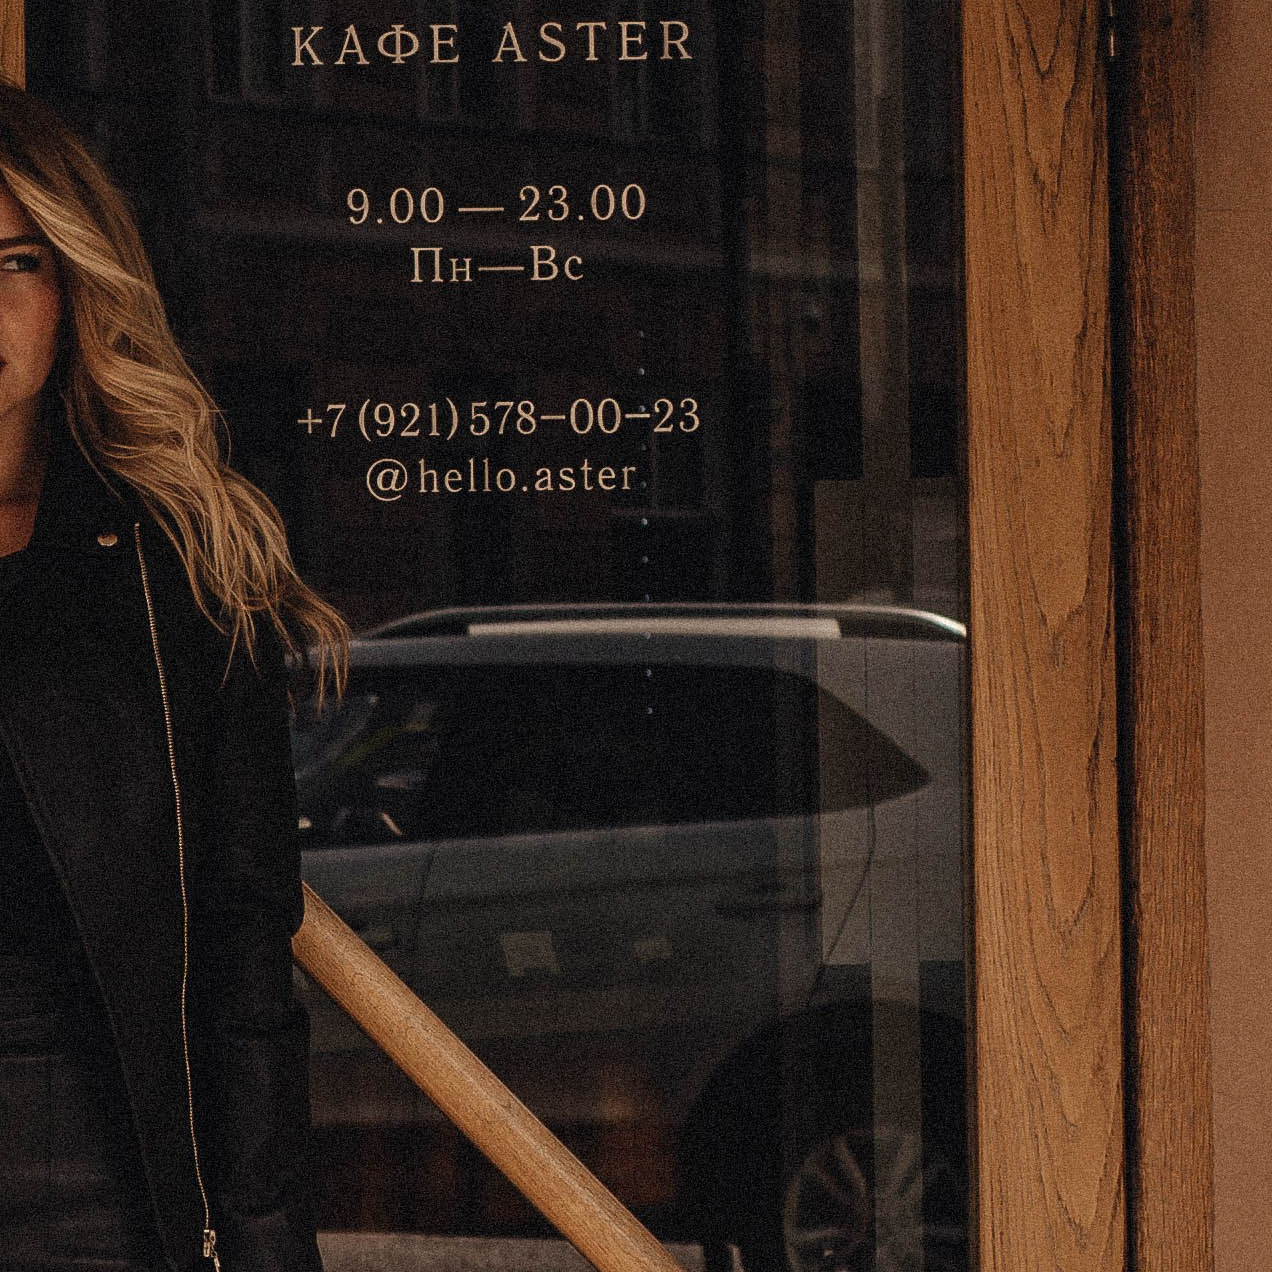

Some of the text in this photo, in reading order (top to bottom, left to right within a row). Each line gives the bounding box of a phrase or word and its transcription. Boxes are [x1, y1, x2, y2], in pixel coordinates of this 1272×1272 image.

[291, 20, 693, 66] КАФЕ ASTER
[346, 187, 445, 225] 9.00
[518, 183, 647, 222] 23.00
[365, 457, 637, 502] @hello.aster
